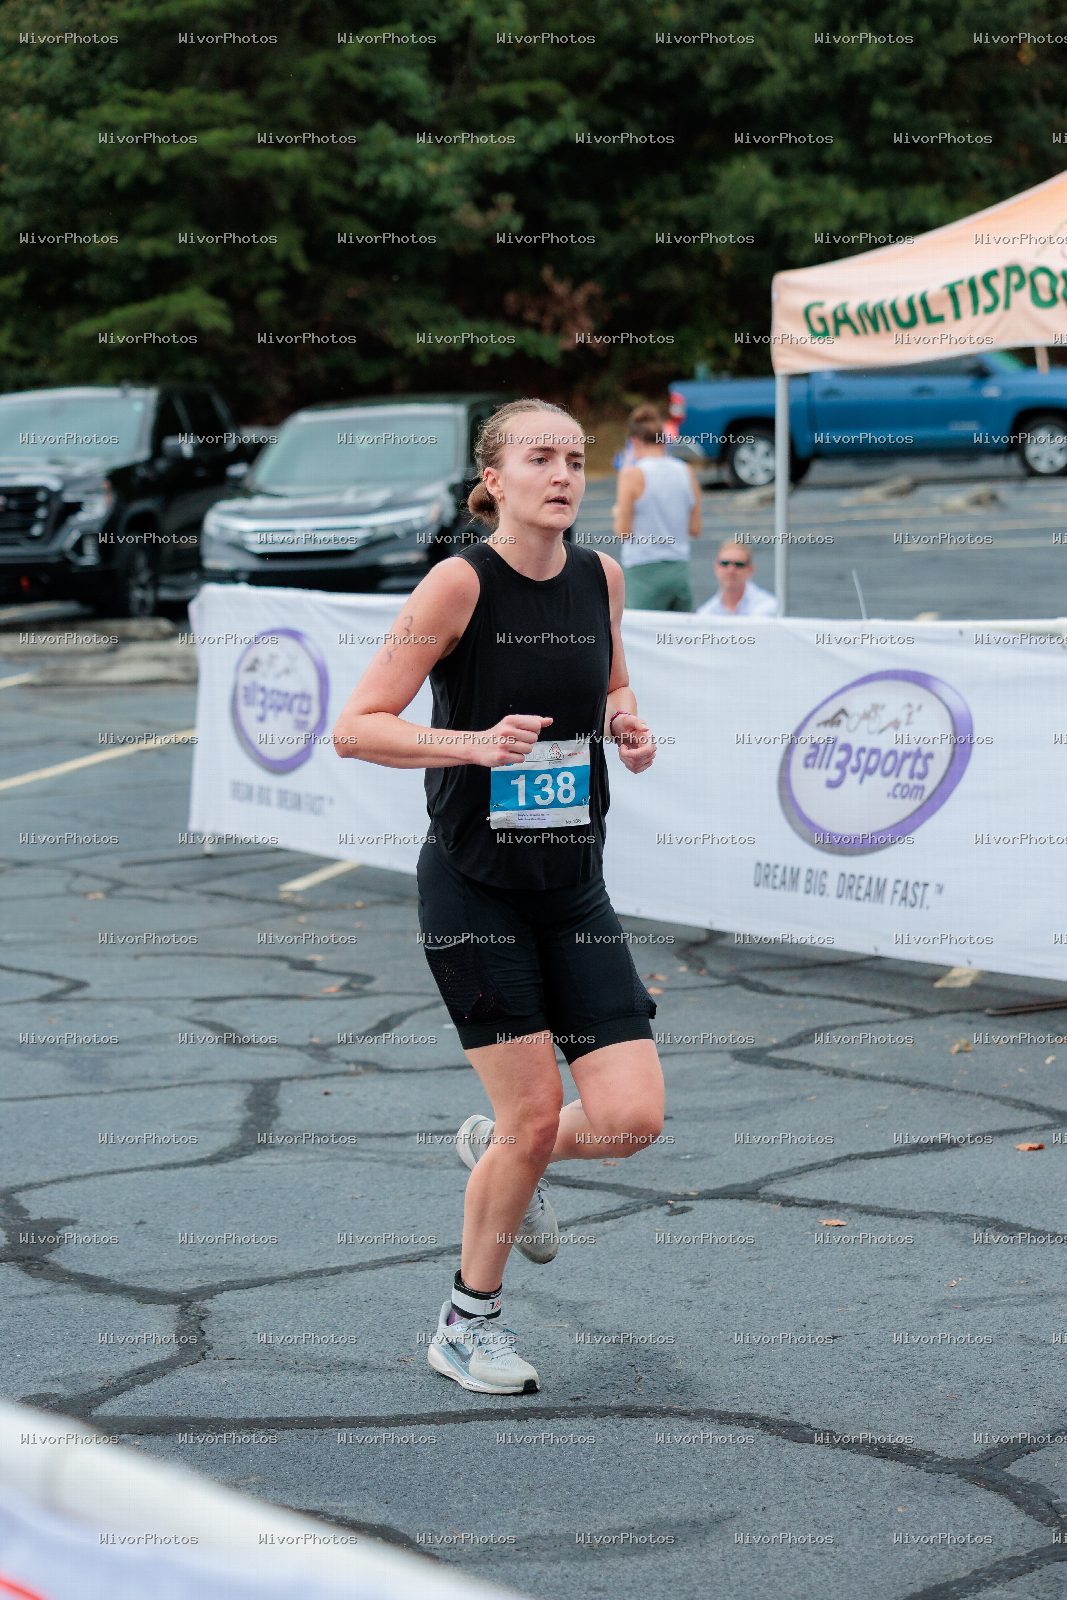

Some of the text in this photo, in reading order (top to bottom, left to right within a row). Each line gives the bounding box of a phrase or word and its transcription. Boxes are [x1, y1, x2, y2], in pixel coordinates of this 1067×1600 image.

[803, 263, 1067, 338] GAMULTISPO
[803, 736, 934, 789] all3sports
[511, 771, 576, 807] 138
[887, 782, 925, 800] .com
[753, 862, 800, 893] DREAM
[804, 868, 830, 897] BIG.
[836, 872, 887, 904] DREAM
[890, 879, 930, 911] FAST.
